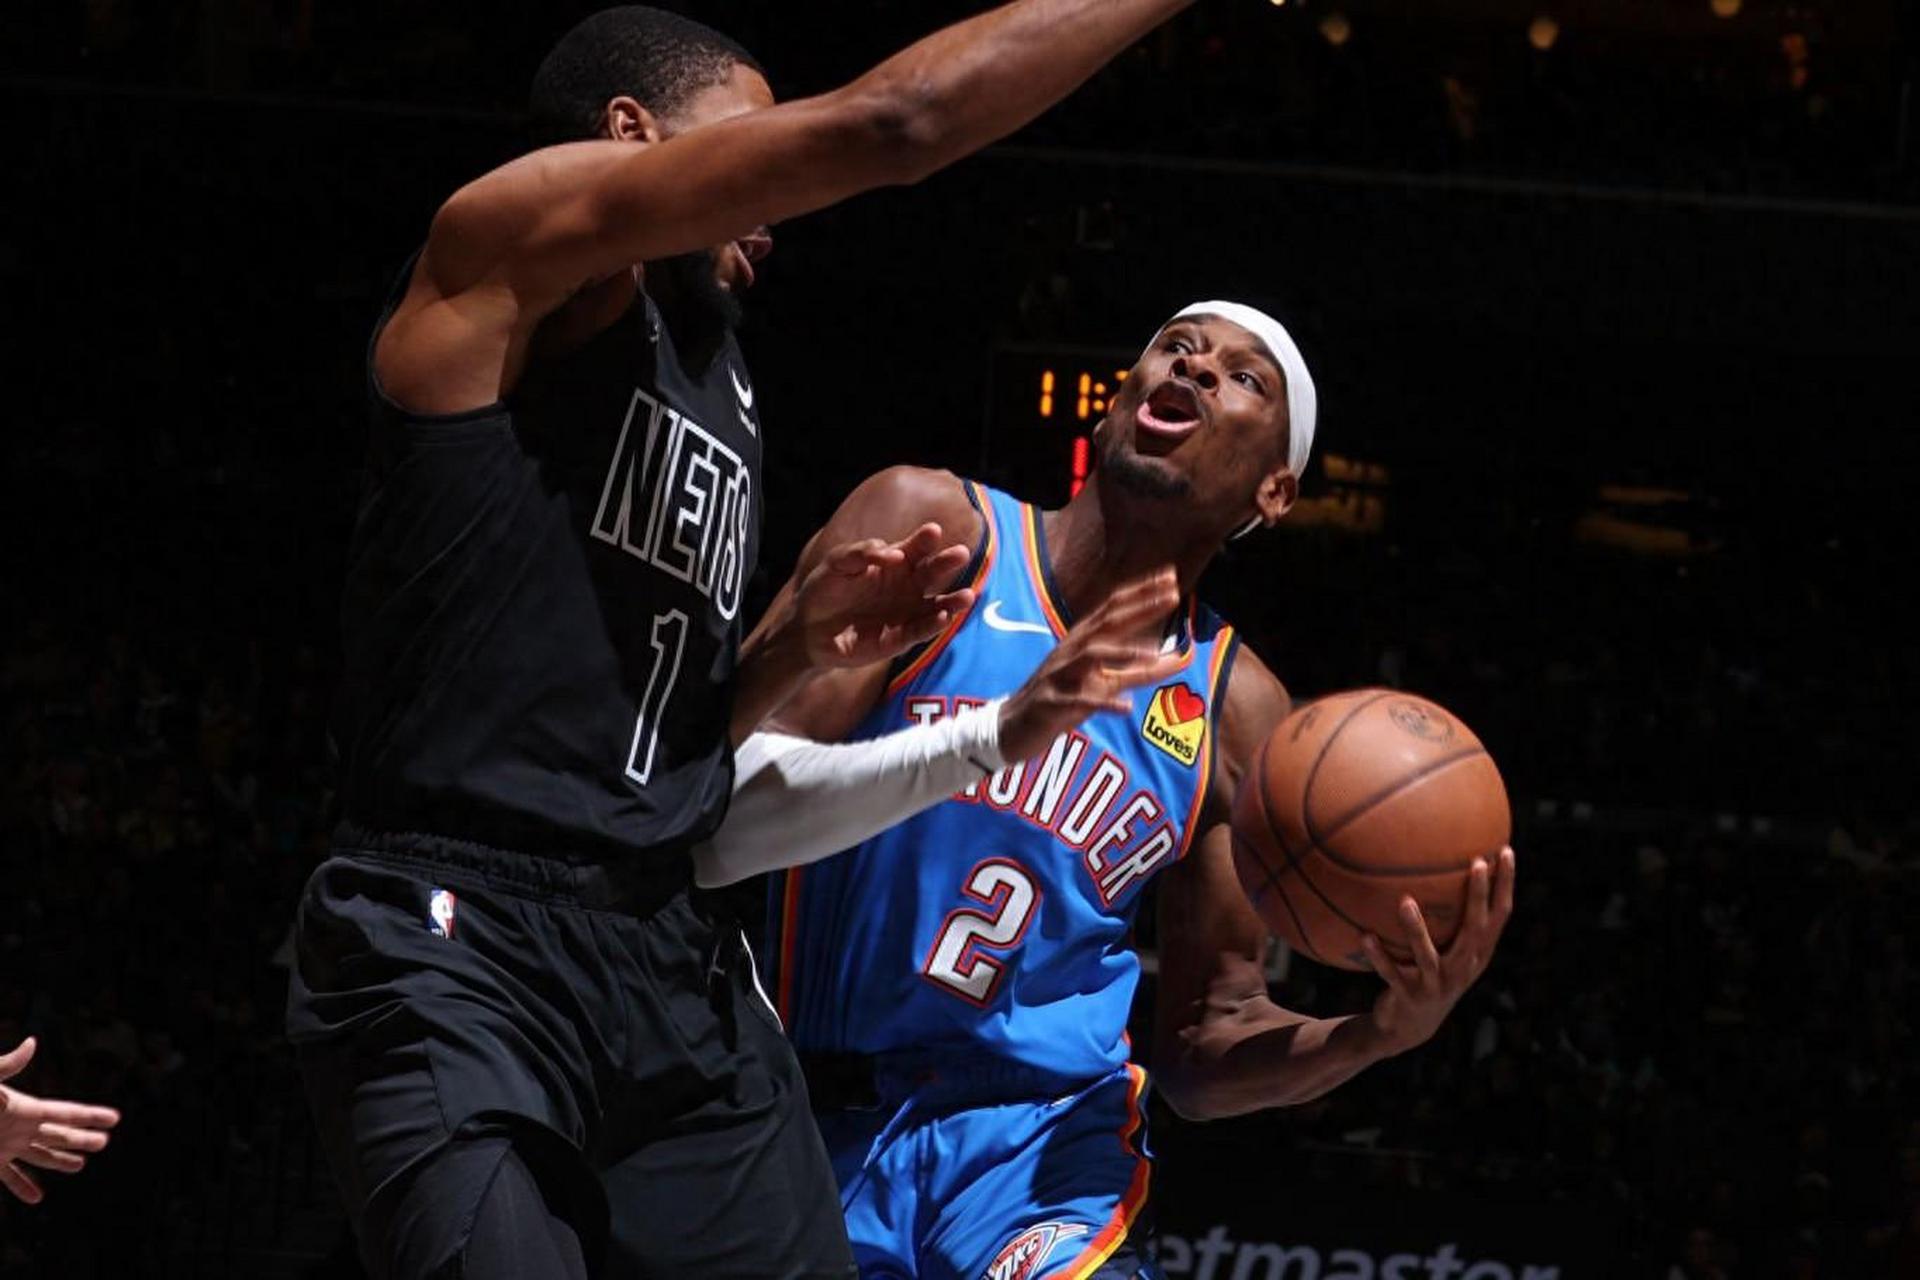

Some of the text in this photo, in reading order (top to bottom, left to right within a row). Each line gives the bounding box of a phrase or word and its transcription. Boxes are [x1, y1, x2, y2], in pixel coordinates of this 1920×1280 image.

[1039, 368, 1130, 421] 11:
[590, 388, 750, 621] NETS
[625, 608, 688, 786] 1
[909, 697, 1177, 907] UNDER
[923, 857, 1042, 1008] 2
